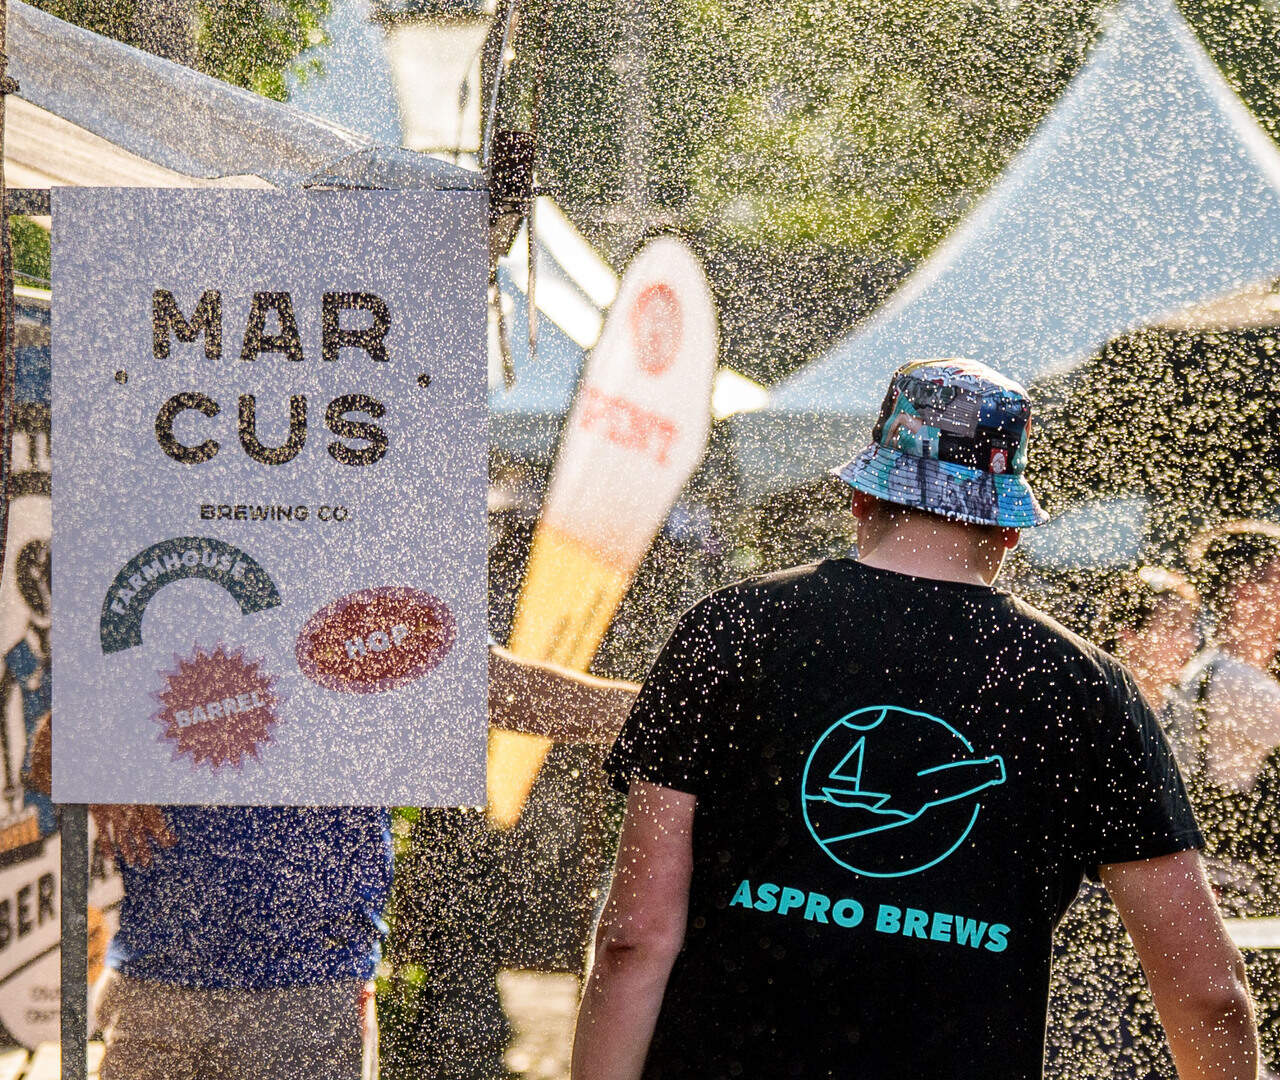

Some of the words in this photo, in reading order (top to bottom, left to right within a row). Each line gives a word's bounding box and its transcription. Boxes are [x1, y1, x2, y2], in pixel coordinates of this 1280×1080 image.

[152, 289, 391, 362] MAR
[154, 391, 389, 466] CUS
[200, 504, 308, 521] BREWING
[110, 550, 247, 615] FARMHOUSE
[344, 624, 407, 659] HOP
[175, 692, 265, 728] BARREL
[730, 880, 863, 927] ASPRO
[876, 904, 1011, 952] BREWS
